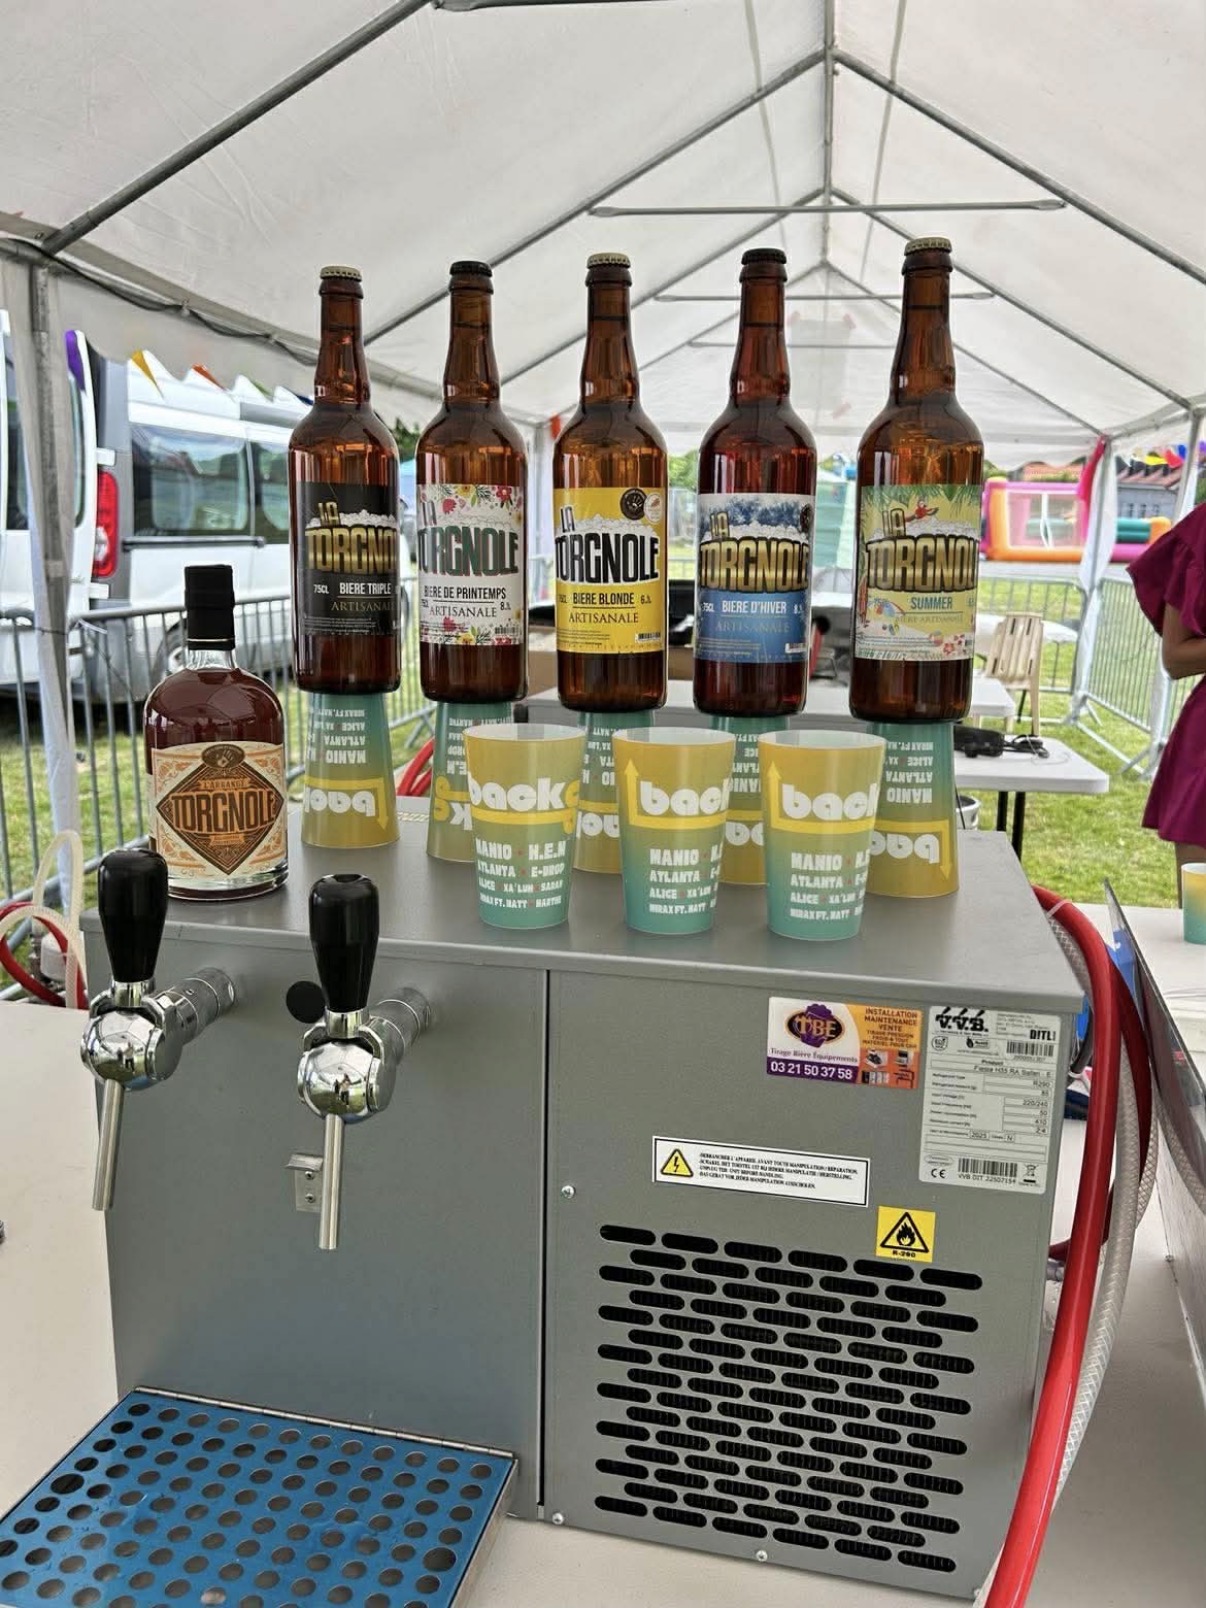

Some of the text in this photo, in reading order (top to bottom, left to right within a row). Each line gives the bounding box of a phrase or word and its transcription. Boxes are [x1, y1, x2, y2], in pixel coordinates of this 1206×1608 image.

[318, 501, 340, 525] LA
[560, 506, 575, 533] LA
[710, 511, 729, 537] LA
[882, 508, 906, 536] LA
[417, 526, 519, 577] TORGNOLE
[555, 532, 659, 584] TORGNOLE
[867, 535, 978, 592] TORGNOL
[313, 582, 391, 594] 75CL BIERE TRIPLE
[444, 587, 454, 599] DE
[456, 587, 506, 600] PRINTEMPS
[573, 593, 596, 605] BIERE
[599, 592, 635, 605] BLONDE
[911, 597, 952, 610] SUMMER
[429, 605, 497, 618] ARTISANALE
[722, 601, 749, 613] BIERE
[751, 602, 787, 614] D'HIVER
[569, 612, 638, 624] ARTISANALE
[324, 736, 366, 745] ATLANTA
[908, 756, 933, 766] ALICE
[886, 771, 933, 783] ATLANTA
[887, 787, 933, 803] MANIO
[171, 790, 275, 832] TORGNOLE
[650, 849, 699, 866] MANIO
[791, 852, 842, 871] MANIO
[478, 860, 516, 877] ATLANTA
[650, 871, 700, 882] ATLANTA
[791, 874, 843, 888] ATLANTA
[649, 888, 677, 899] ALICE
[790, 892, 819, 905] ALICE
[865, 1008, 918, 1018] INSTALLATION
[796, 1016, 837, 1038] TBE
[864, 1016, 917, 1026] MAINTENANCE
[878, 1024, 903, 1032] VENTE
[770, 1047, 791, 1057] Tirage
[770, 1061, 853, 1079] 03 21 50 37 58
